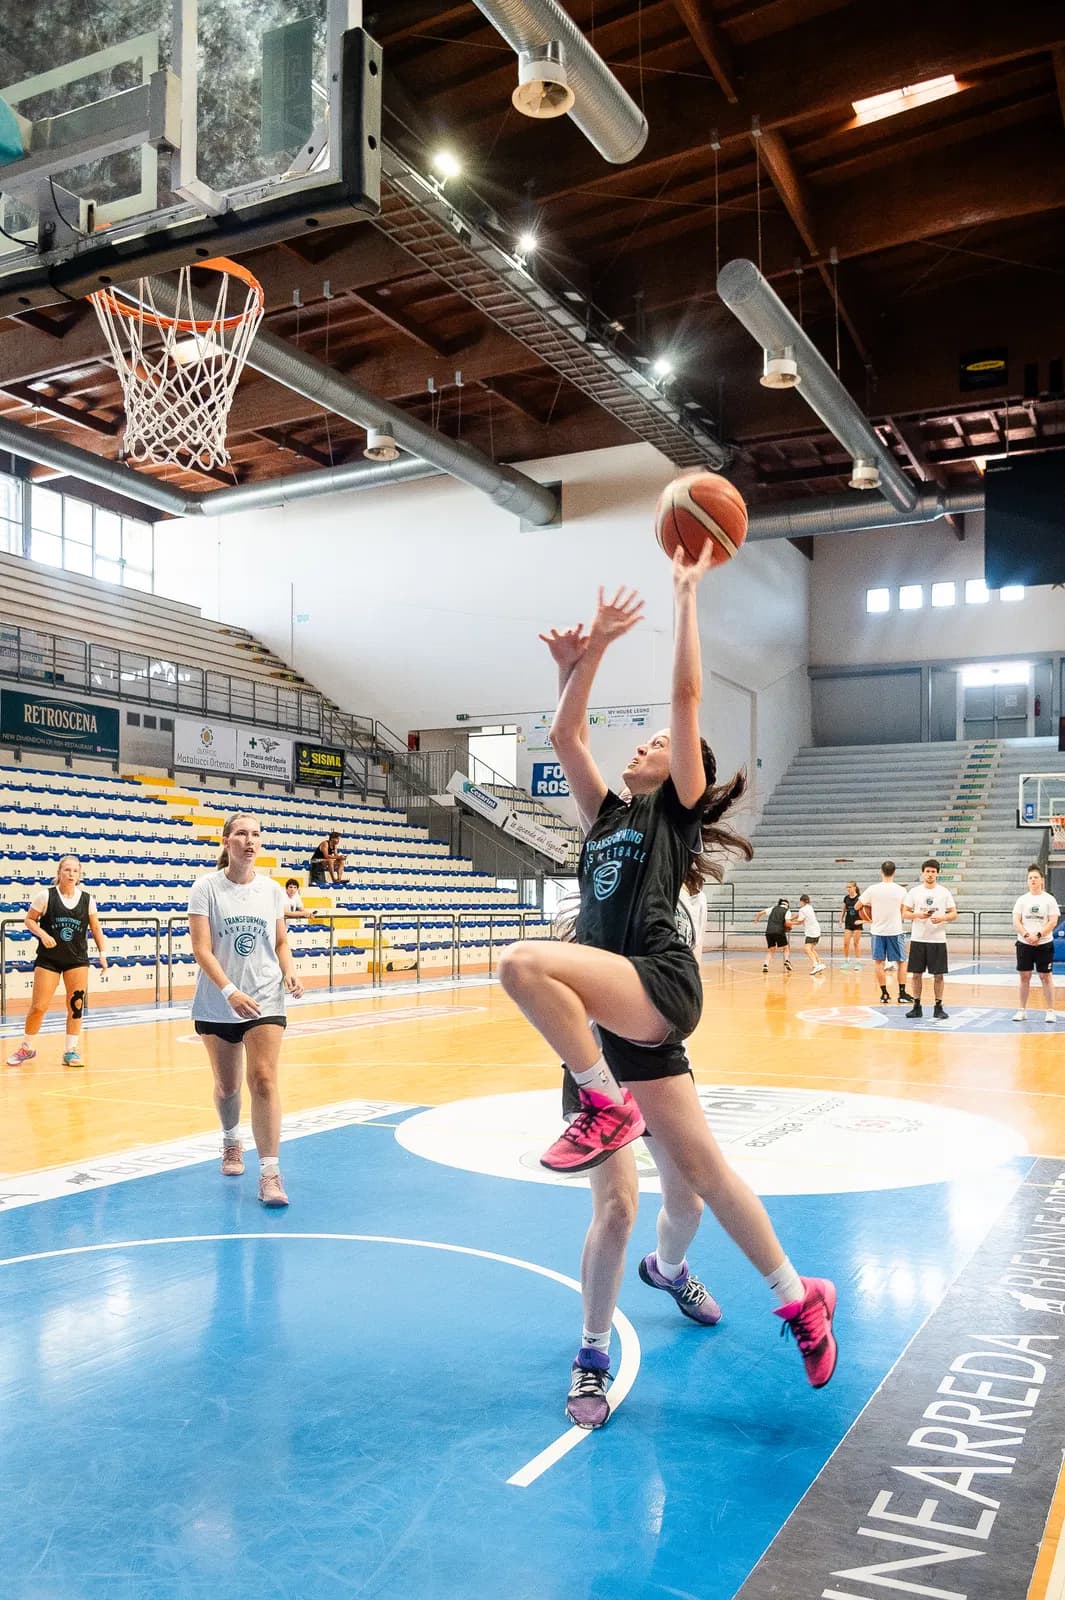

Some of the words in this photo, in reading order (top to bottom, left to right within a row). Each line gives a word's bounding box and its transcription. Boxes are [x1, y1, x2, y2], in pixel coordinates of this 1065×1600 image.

[24, 704, 98, 734] RETROSCENA
[243, 759, 249, 767] Di
[250, 760, 286, 773] Bonaventura
[311, 753, 341, 767] SISMA
[543, 765, 566, 779] FO
[469, 787, 497, 809] Cesarini
[224, 916, 268, 928] TRANSFORMING
[821, 1334, 1060, 1600] NEARREDA
